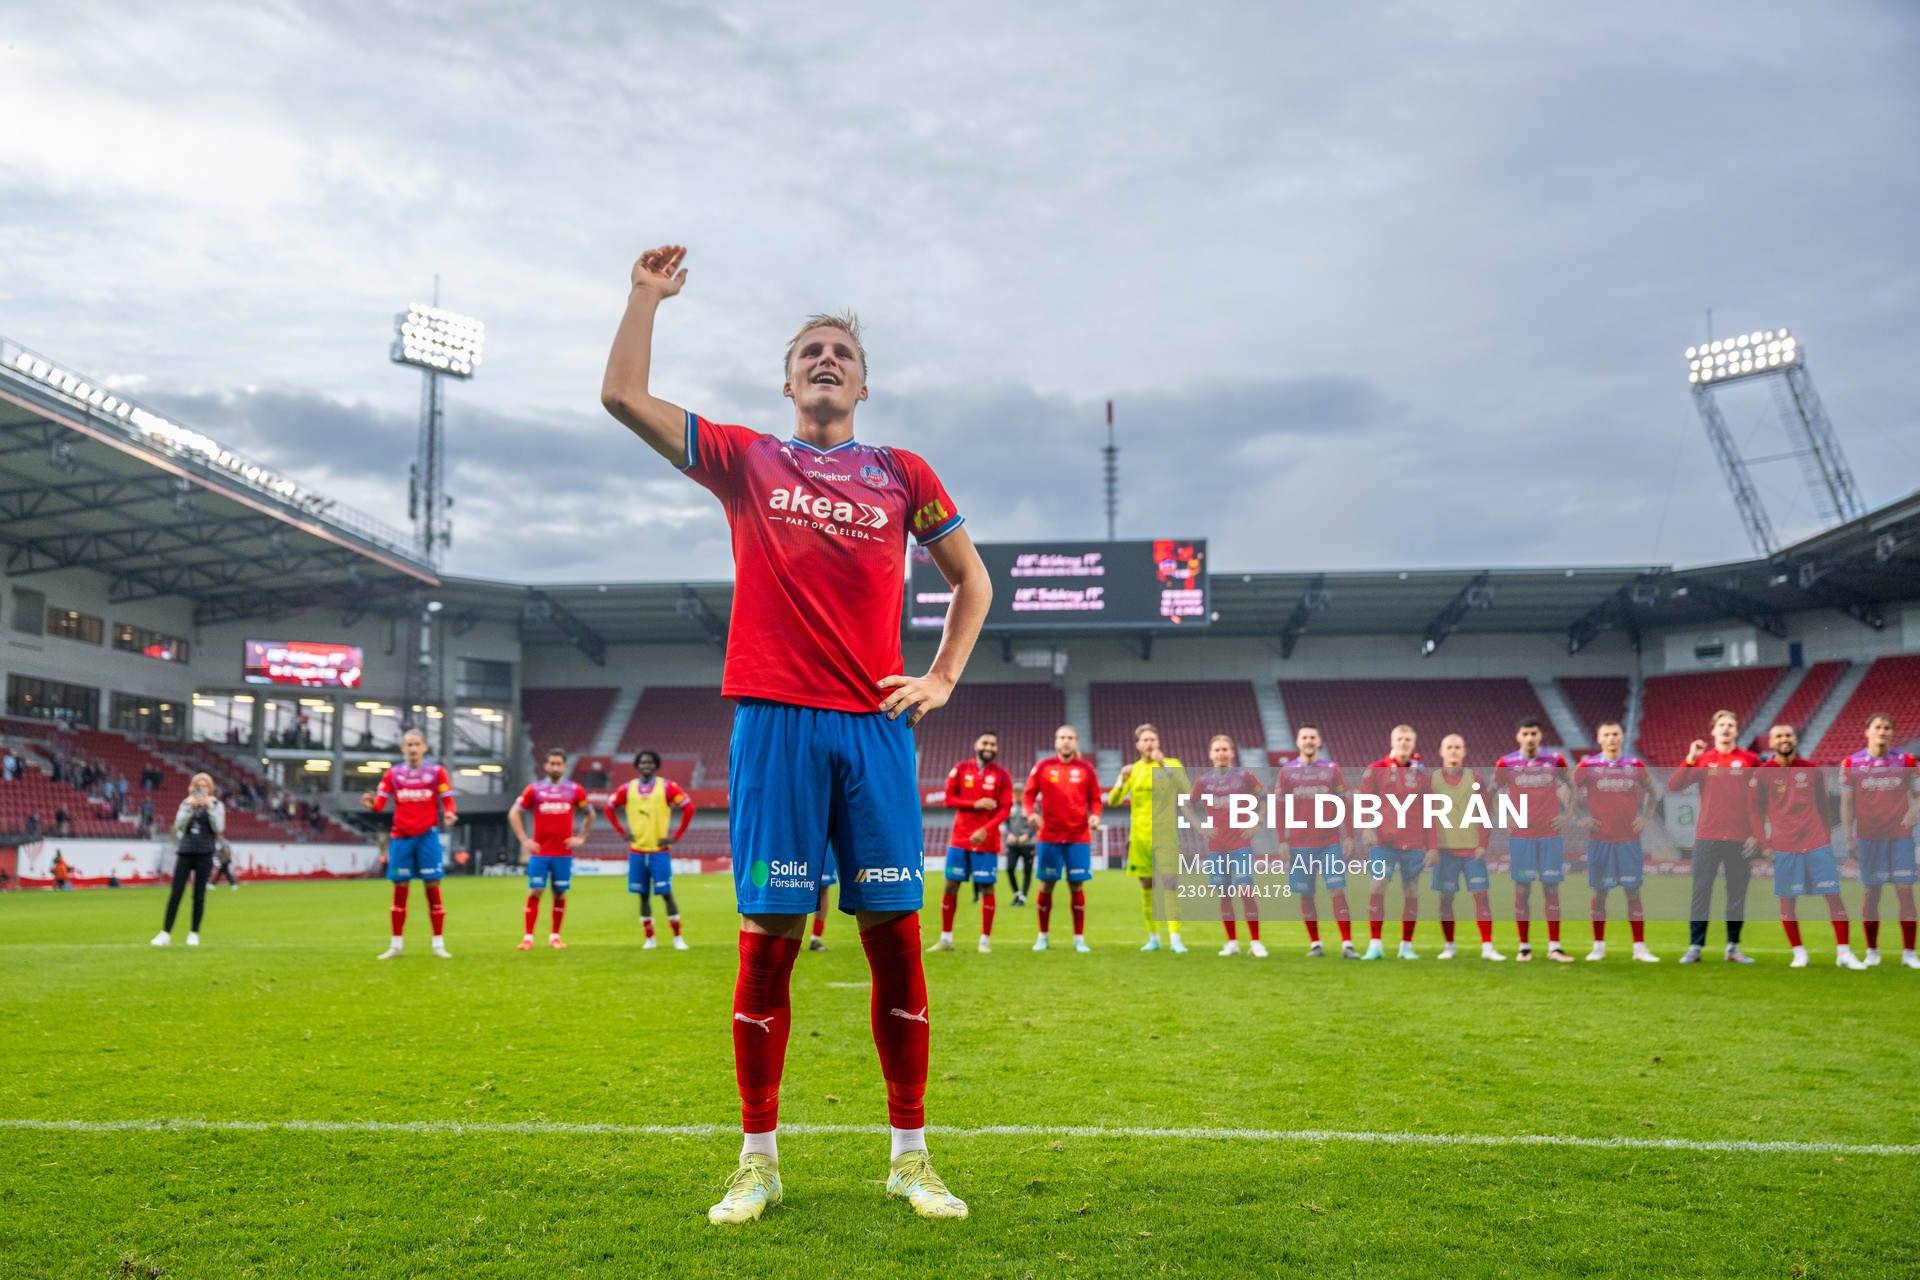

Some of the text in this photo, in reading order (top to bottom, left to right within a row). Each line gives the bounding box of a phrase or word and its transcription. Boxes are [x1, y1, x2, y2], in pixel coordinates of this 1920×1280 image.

[769, 486, 853, 523] akea
[785, 516, 870, 541] PART OF ELEDA
[770, 860, 808, 876] Solid
[866, 867, 912, 883] RSA
[770, 877, 815, 891] Försäkring
